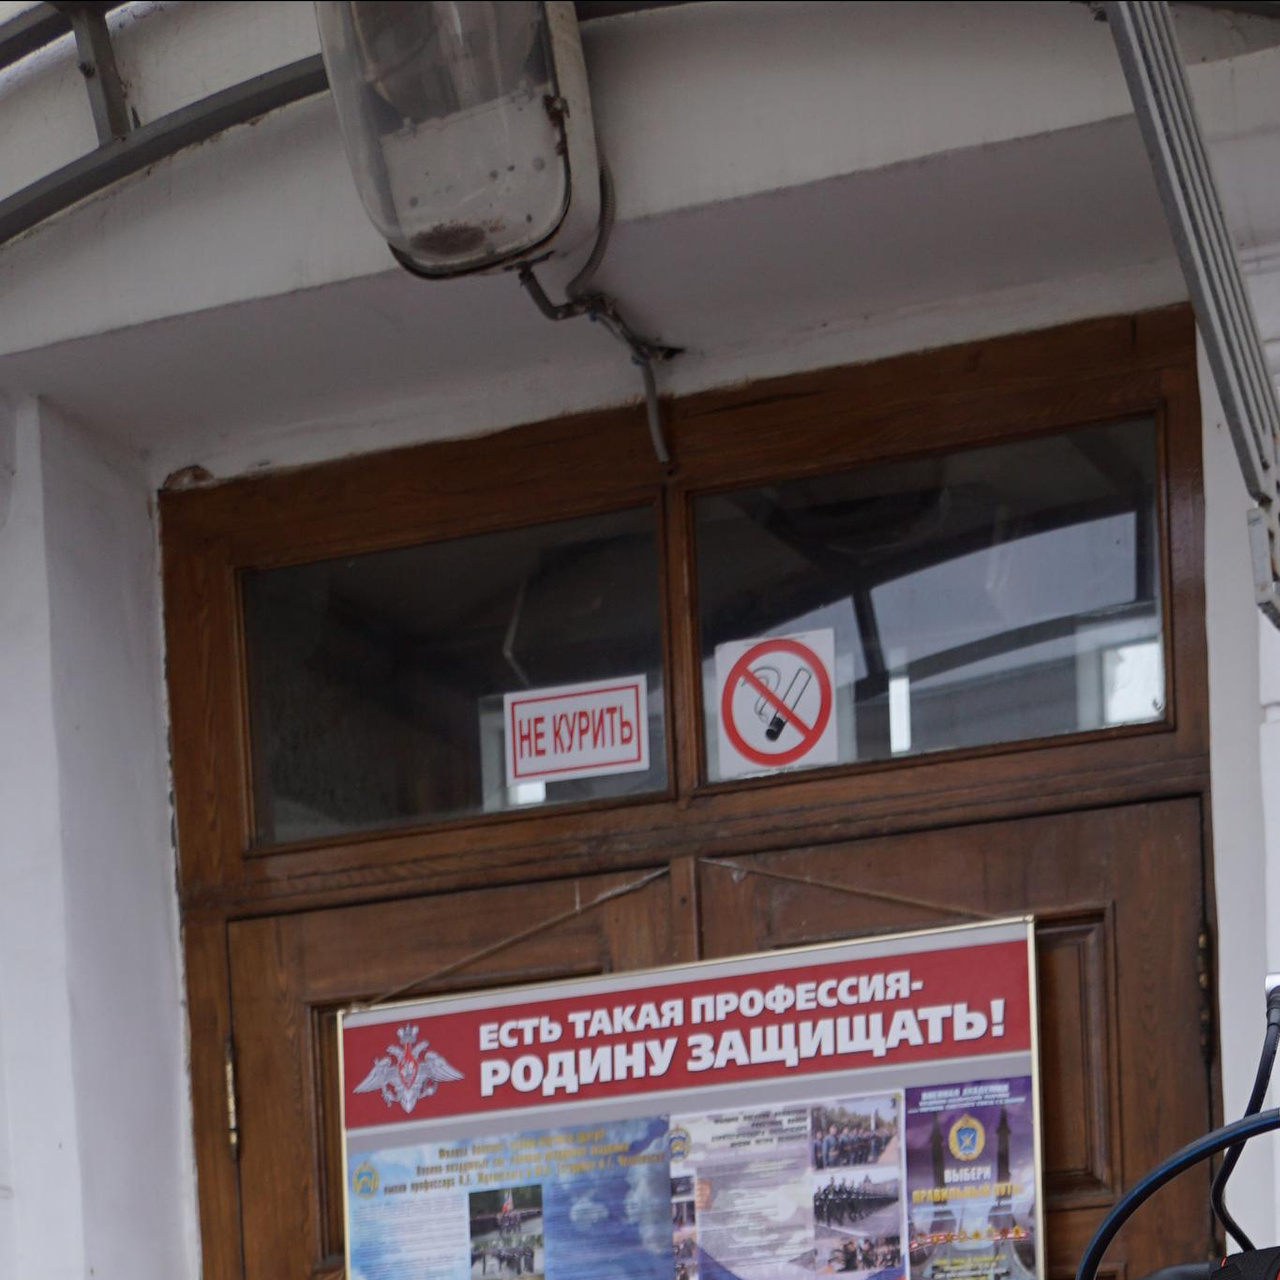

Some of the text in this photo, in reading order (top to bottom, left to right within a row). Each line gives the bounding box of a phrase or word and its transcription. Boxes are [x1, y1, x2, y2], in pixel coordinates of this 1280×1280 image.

[519, 705, 633, 759] НЕ КУРИТЬ
[479, 969, 923, 1051] ЕСТЬ ТАКАЯ ПРОФЕССИЯ-
[480, 998, 1005, 1097] РОДИНУ ЗАЩИЩАТЬ!
[912, 1183, 990, 1204] ПРАВИЛЬНЫЙ
[944, 1166, 991, 1183] ВЫБЕРИ
